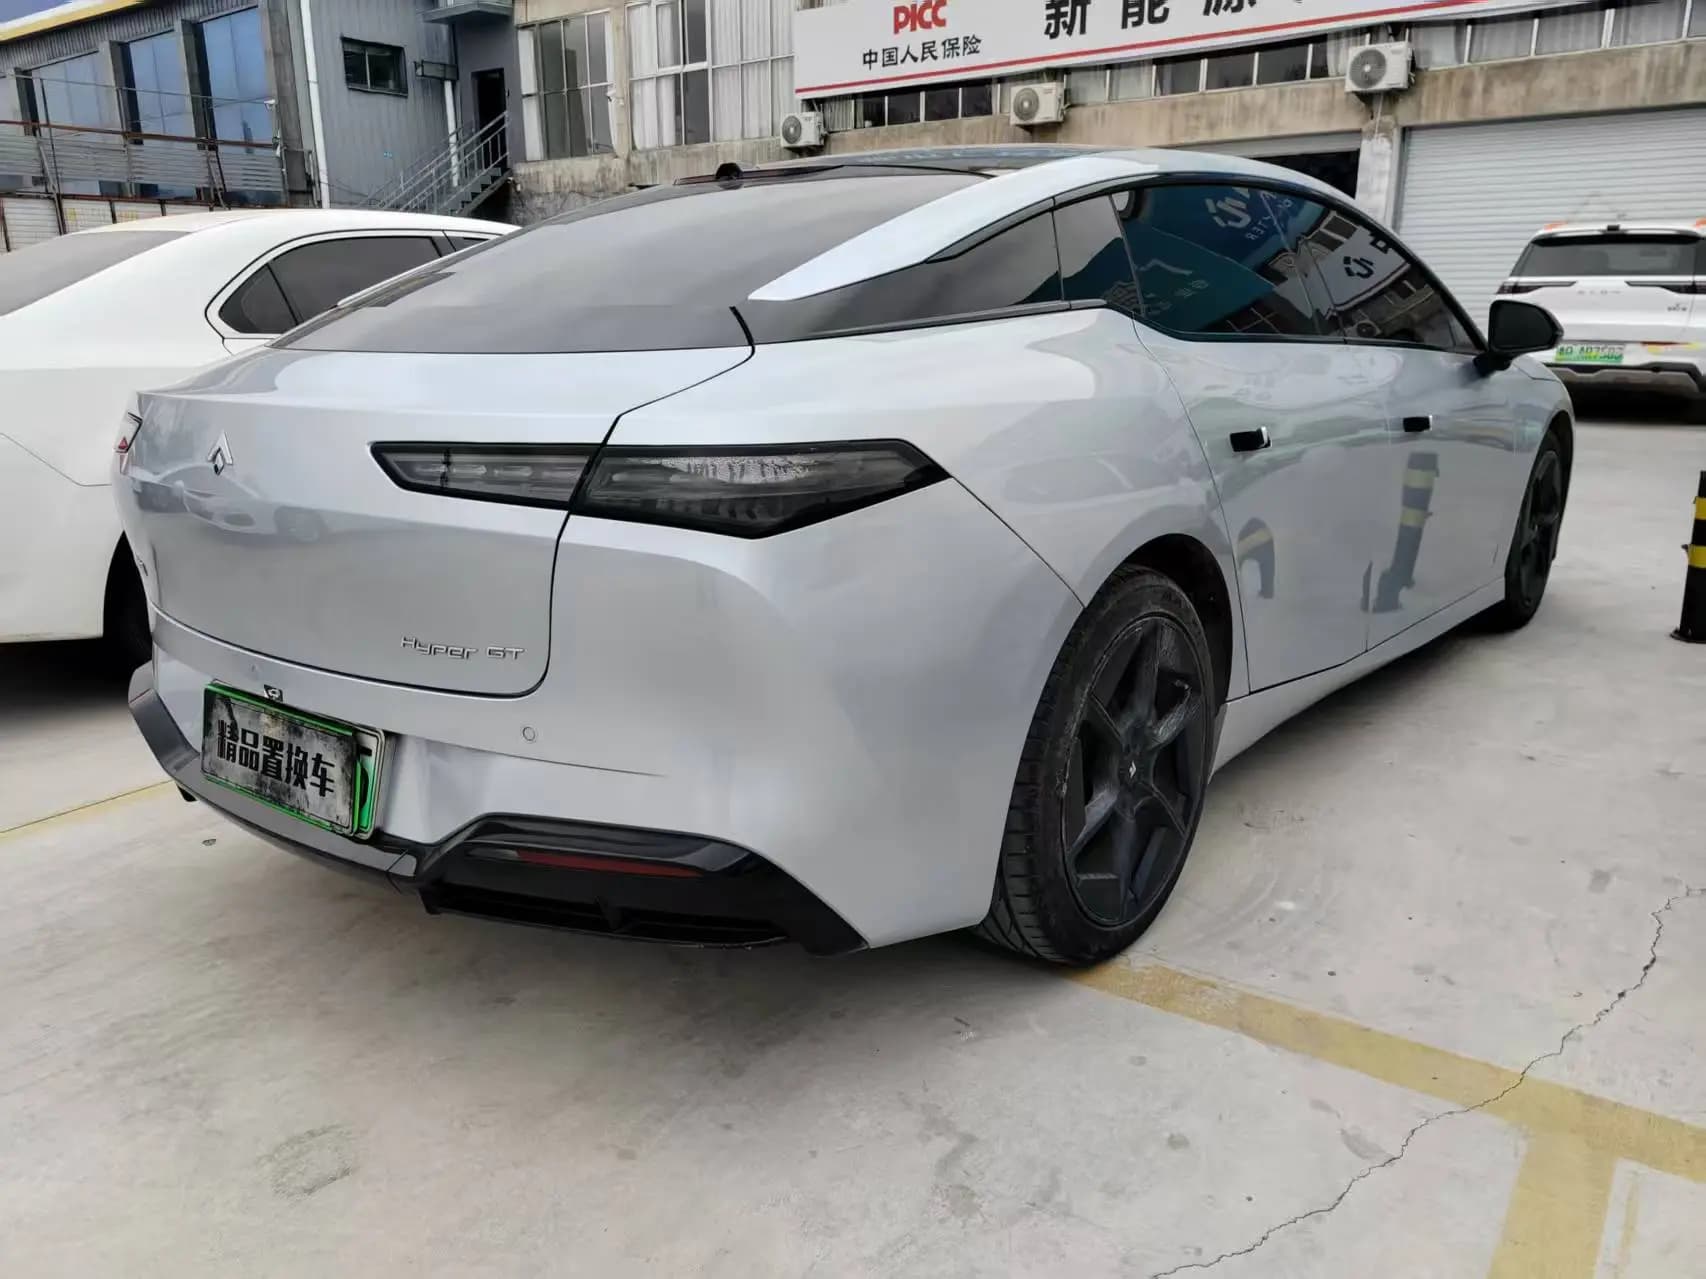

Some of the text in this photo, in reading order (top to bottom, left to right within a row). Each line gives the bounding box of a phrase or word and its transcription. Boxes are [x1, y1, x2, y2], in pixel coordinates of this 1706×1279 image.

[893, 0, 947, 34] PICC
[862, 34, 982, 71] 中国人民保险
[486, 646, 525, 660] GT
[217, 719, 335, 797] 精品置换车
